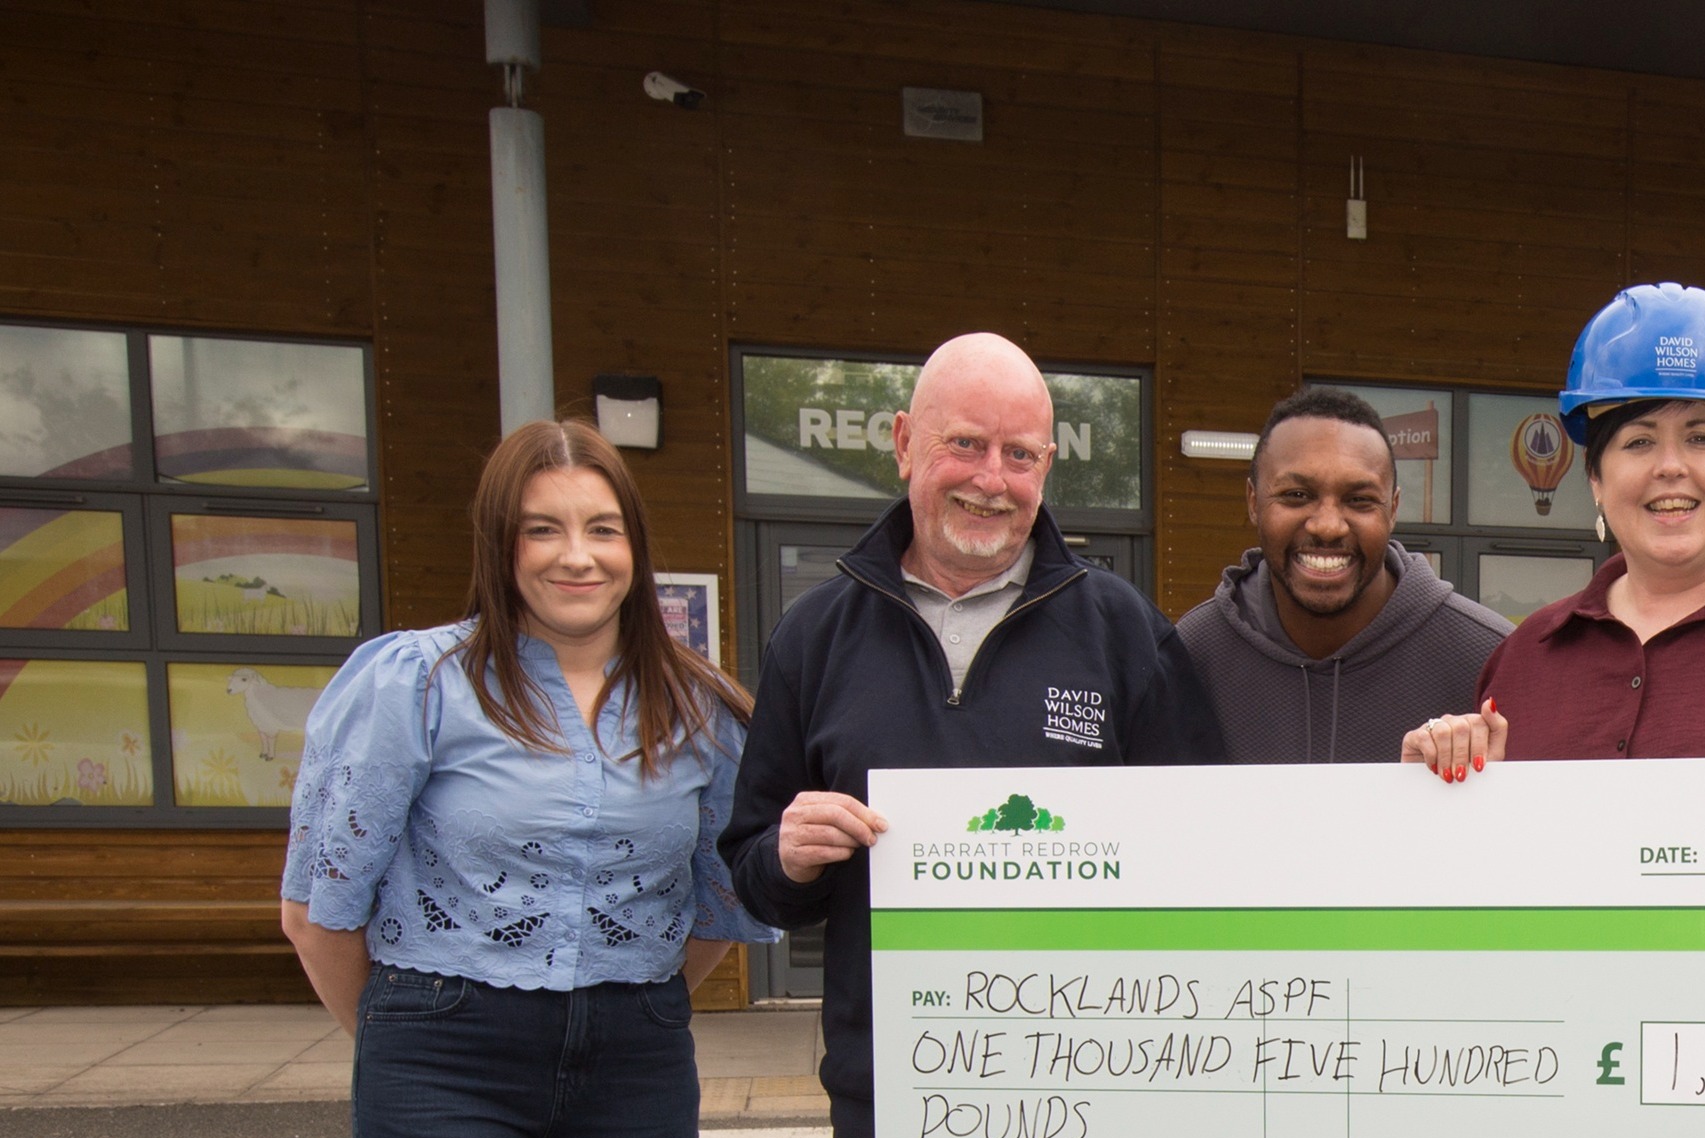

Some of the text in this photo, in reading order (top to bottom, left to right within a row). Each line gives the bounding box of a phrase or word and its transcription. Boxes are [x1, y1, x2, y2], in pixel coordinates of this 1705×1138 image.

[1660, 336, 1693, 346] DAVID
[1655, 346, 1698, 358] WILSON
[1657, 357, 1696, 368] HOMES
[1389, 428, 1431, 446] ption
[1047, 687, 1102, 705] DAVID
[1044, 699, 1105, 722] WILSON
[1047, 714, 1100, 736] HOMES
[913, 842, 1120, 857] BARRATT REDROW
[1639, 847, 1698, 864] DATE:
[913, 860, 1120, 881] FOUNDATION
[912, 971, 1331, 1019] PAY: ROCKLANDS ASPF
[912, 1029, 1559, 1093] ONE THOUSAND FIVE HUNDRED
